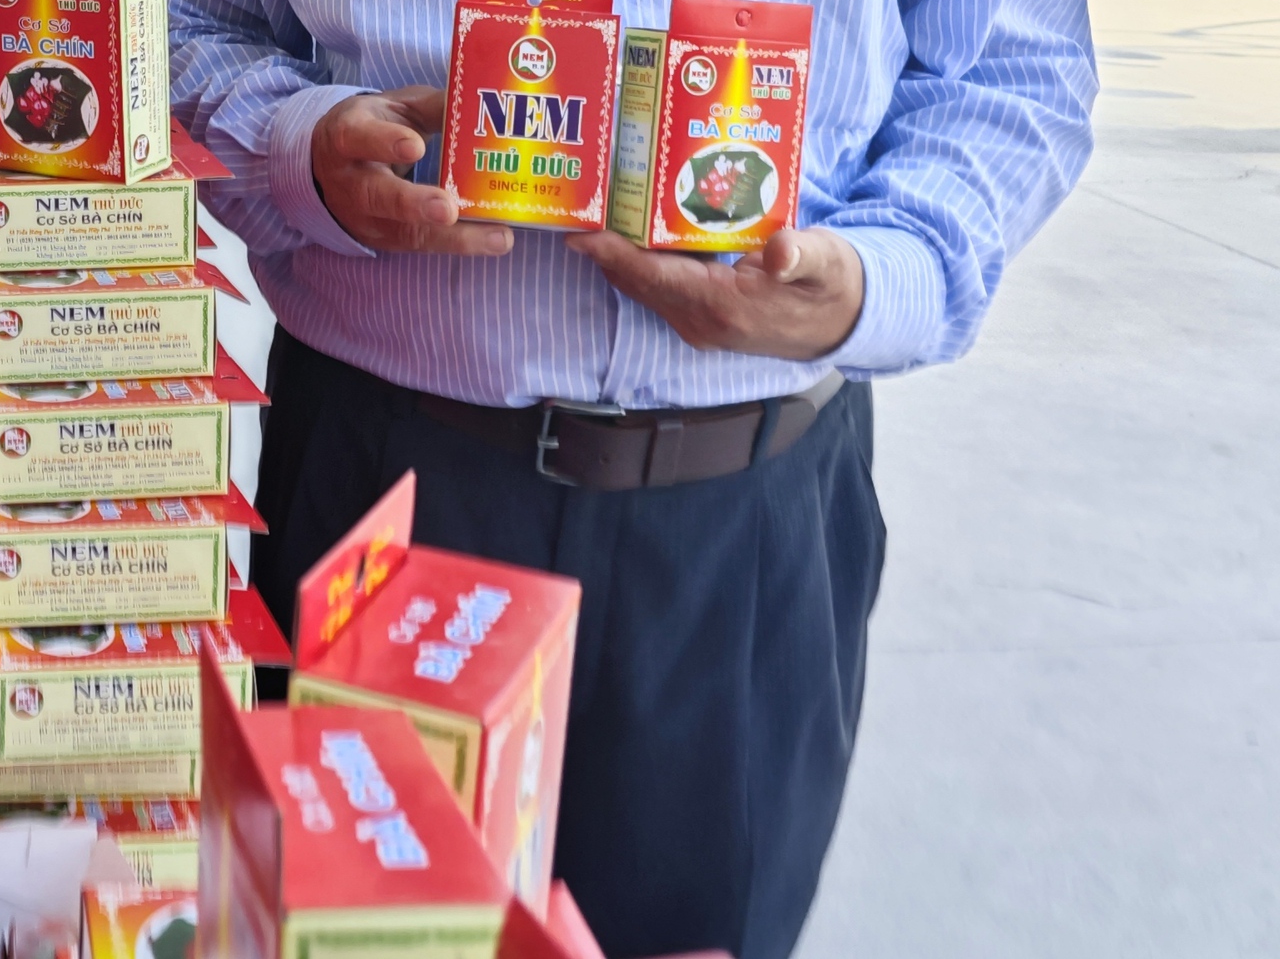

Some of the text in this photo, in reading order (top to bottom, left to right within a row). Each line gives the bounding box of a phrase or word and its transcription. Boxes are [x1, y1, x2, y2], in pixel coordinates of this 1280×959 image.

[19, 17, 71, 34] Cơ Sở
[137, 0, 146, 38] CHÍN
[2, 33, 95, 59] BÀ CHÍN
[522, 53, 544, 62] NEM
[627, 44, 657, 69] NEM
[692, 70, 708, 78] NEM
[752, 65, 794, 87] NEM
[130, 57, 140, 111] NEM
[751, 86, 770, 99] THỦ
[474, 87, 587, 145] NEM
[710, 102, 762, 119] Cơ Sở
[688, 117, 781, 142] BÀ CHÍN
[473, 147, 582, 180] THỦ ĐỨC
[488, 178, 561, 197] SINCE 1972
[35, 194, 144, 213] NEM THỦ ĐỨC
[37, 209, 143, 226] Cơ Sở BÀ CHÍN
[50, 303, 161, 323] NEM THỦ ĐỨC
[51, 320, 161, 337] Cơ Sở BÀ CHÍN
[59, 423, 116, 440] NEM
[120, 421, 144, 438] THỦ
[60, 437, 173, 454] Cơ Sở BÀ CHÍN
[51, 542, 110, 562] NEM
